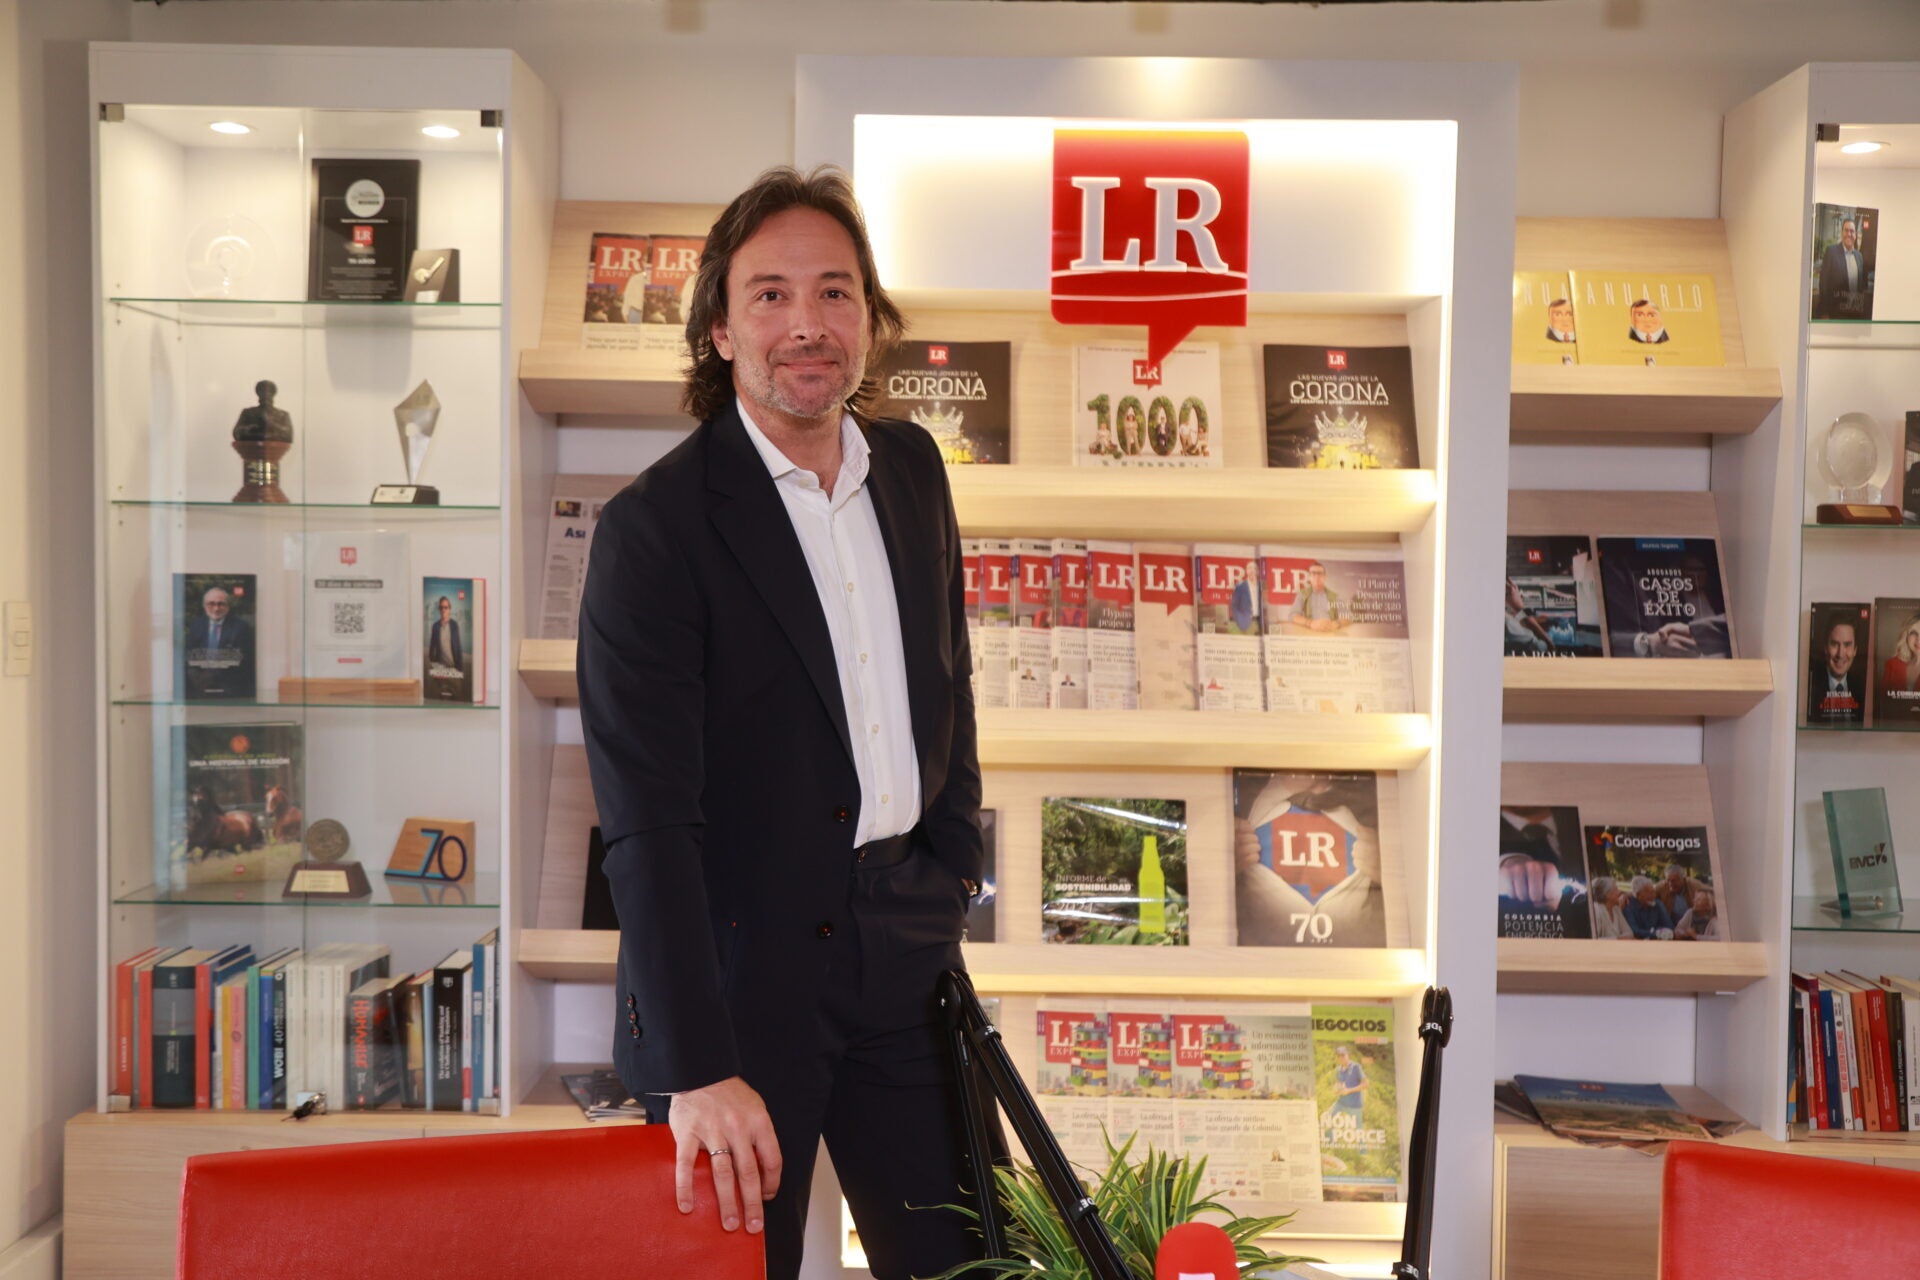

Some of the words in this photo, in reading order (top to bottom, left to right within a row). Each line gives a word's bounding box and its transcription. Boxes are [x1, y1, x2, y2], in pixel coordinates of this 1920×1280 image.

[1070, 176, 1229, 274] LR
[601, 246, 642, 272] LR
[656, 247, 699, 272] LR
[1586, 281, 1703, 310] ANUARIO
[929, 349, 947, 361] LR
[1327, 353, 1345, 366] LR
[1134, 364, 1160, 381] LR
[888, 375, 987, 397] CORONA
[1289, 380, 1389, 401] CORONA
[1087, 393, 1210, 456] 1000
[1097, 562, 1135, 590] LR
[1143, 564, 1189, 593] LR
[1368, 579, 1387, 590] Plan
[1388, 580, 1400, 590] de
[1640, 577, 1694, 591] CASOS
[1356, 590, 1401, 600] Desarrollo
[1656, 591, 1680, 603] DE
[1372, 600, 1383, 610] de
[1644, 600, 1696, 617] ÉXITO
[1278, 829, 1340, 869] LR
[1614, 833, 1702, 851] Coopidrogas
[1055, 874, 1095, 883] INFORME
[1055, 883, 1132, 892] SOSTENIBILIDAD
[1504, 913, 1562, 922] COLOMBIA
[1504, 920, 1564, 932] POTENCIA
[1289, 912, 1334, 944] 70
[273, 1047, 284, 1079] WOBI
[1275, 1052, 1309, 1061] millones
[1264, 1063, 1274, 1072] de
[1332, 1129, 1387, 1144] PORCE
